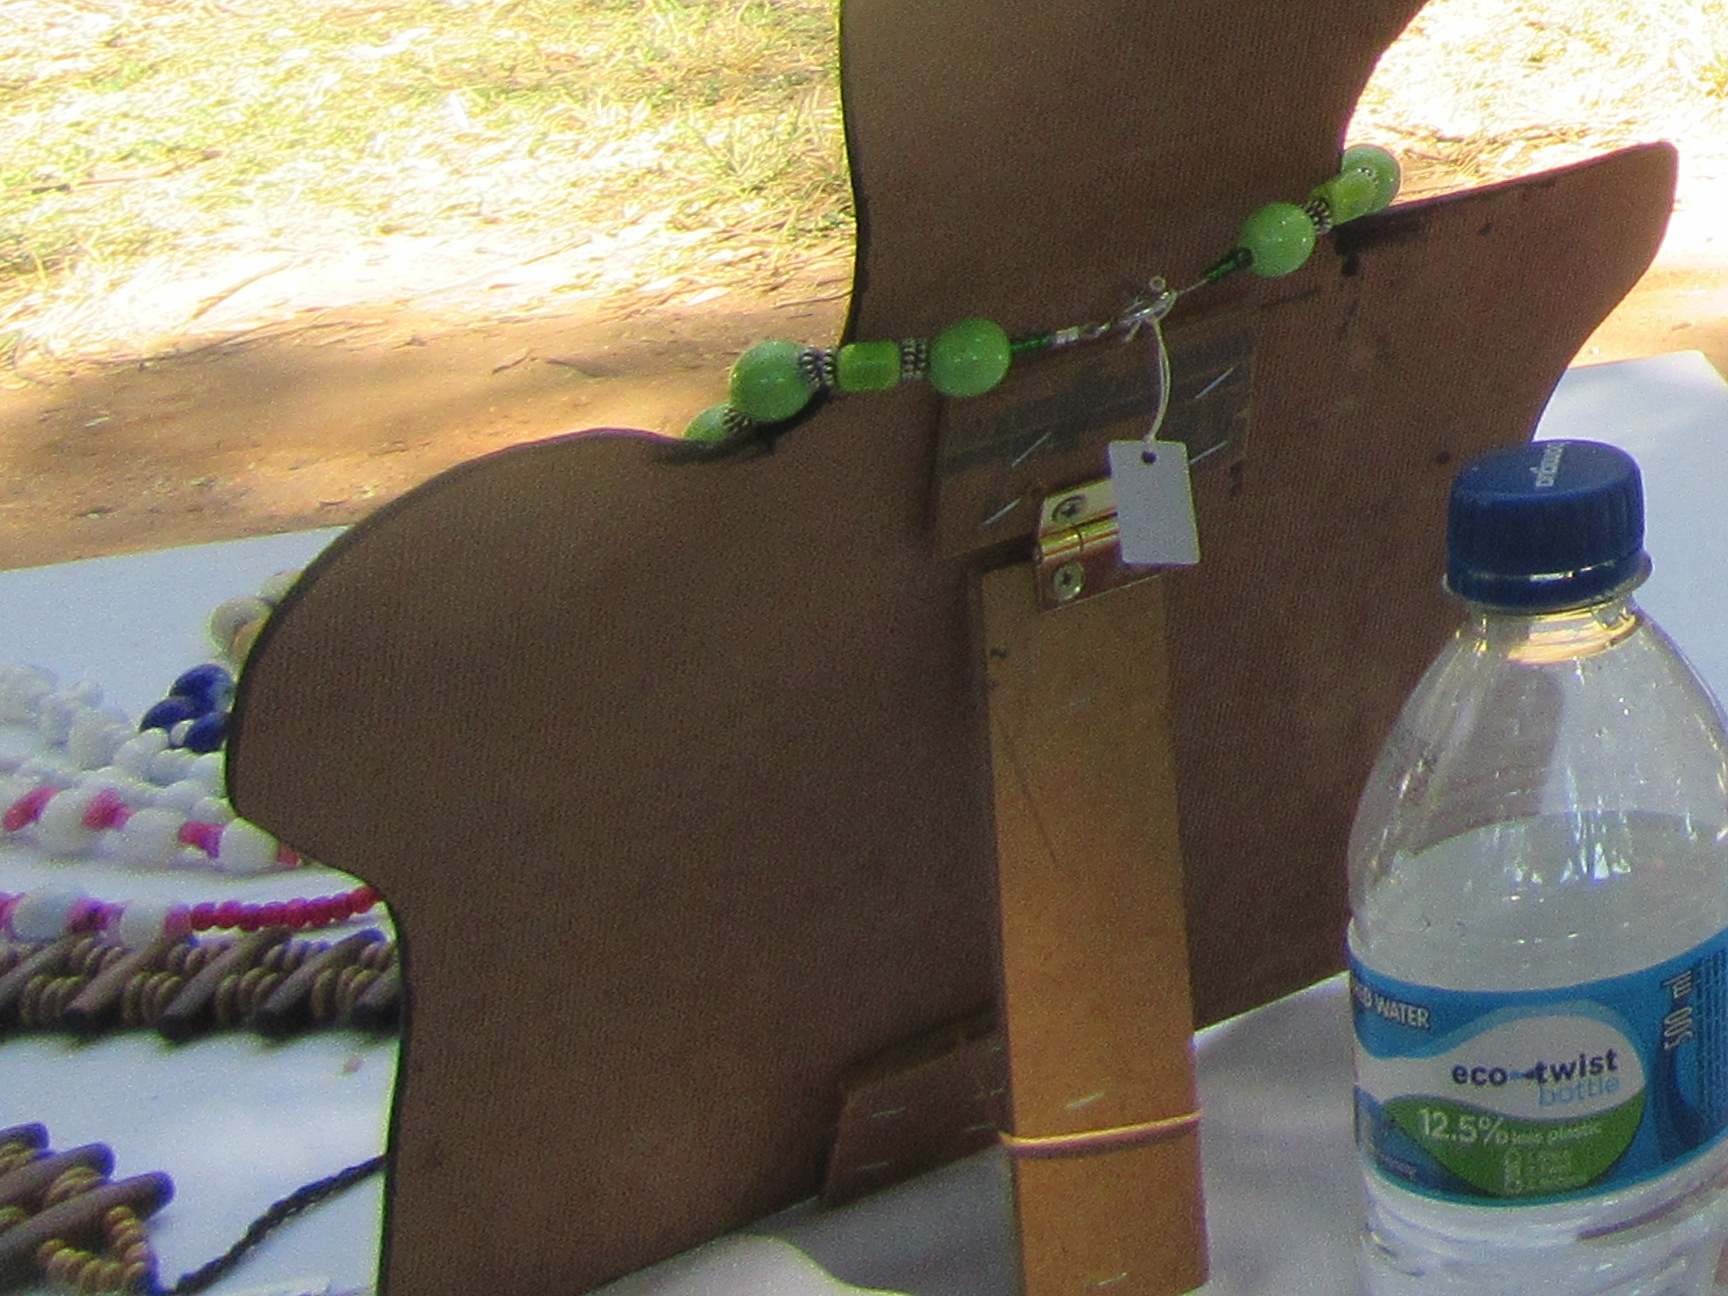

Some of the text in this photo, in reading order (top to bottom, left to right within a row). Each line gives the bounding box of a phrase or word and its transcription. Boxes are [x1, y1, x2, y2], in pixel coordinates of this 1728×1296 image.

[1375, 992, 1430, 1029] WATER
[1663, 1006, 1694, 1050] 500
[1539, 1076, 1620, 1107] bottle
[1419, 1107, 1509, 1146] 12.5%
